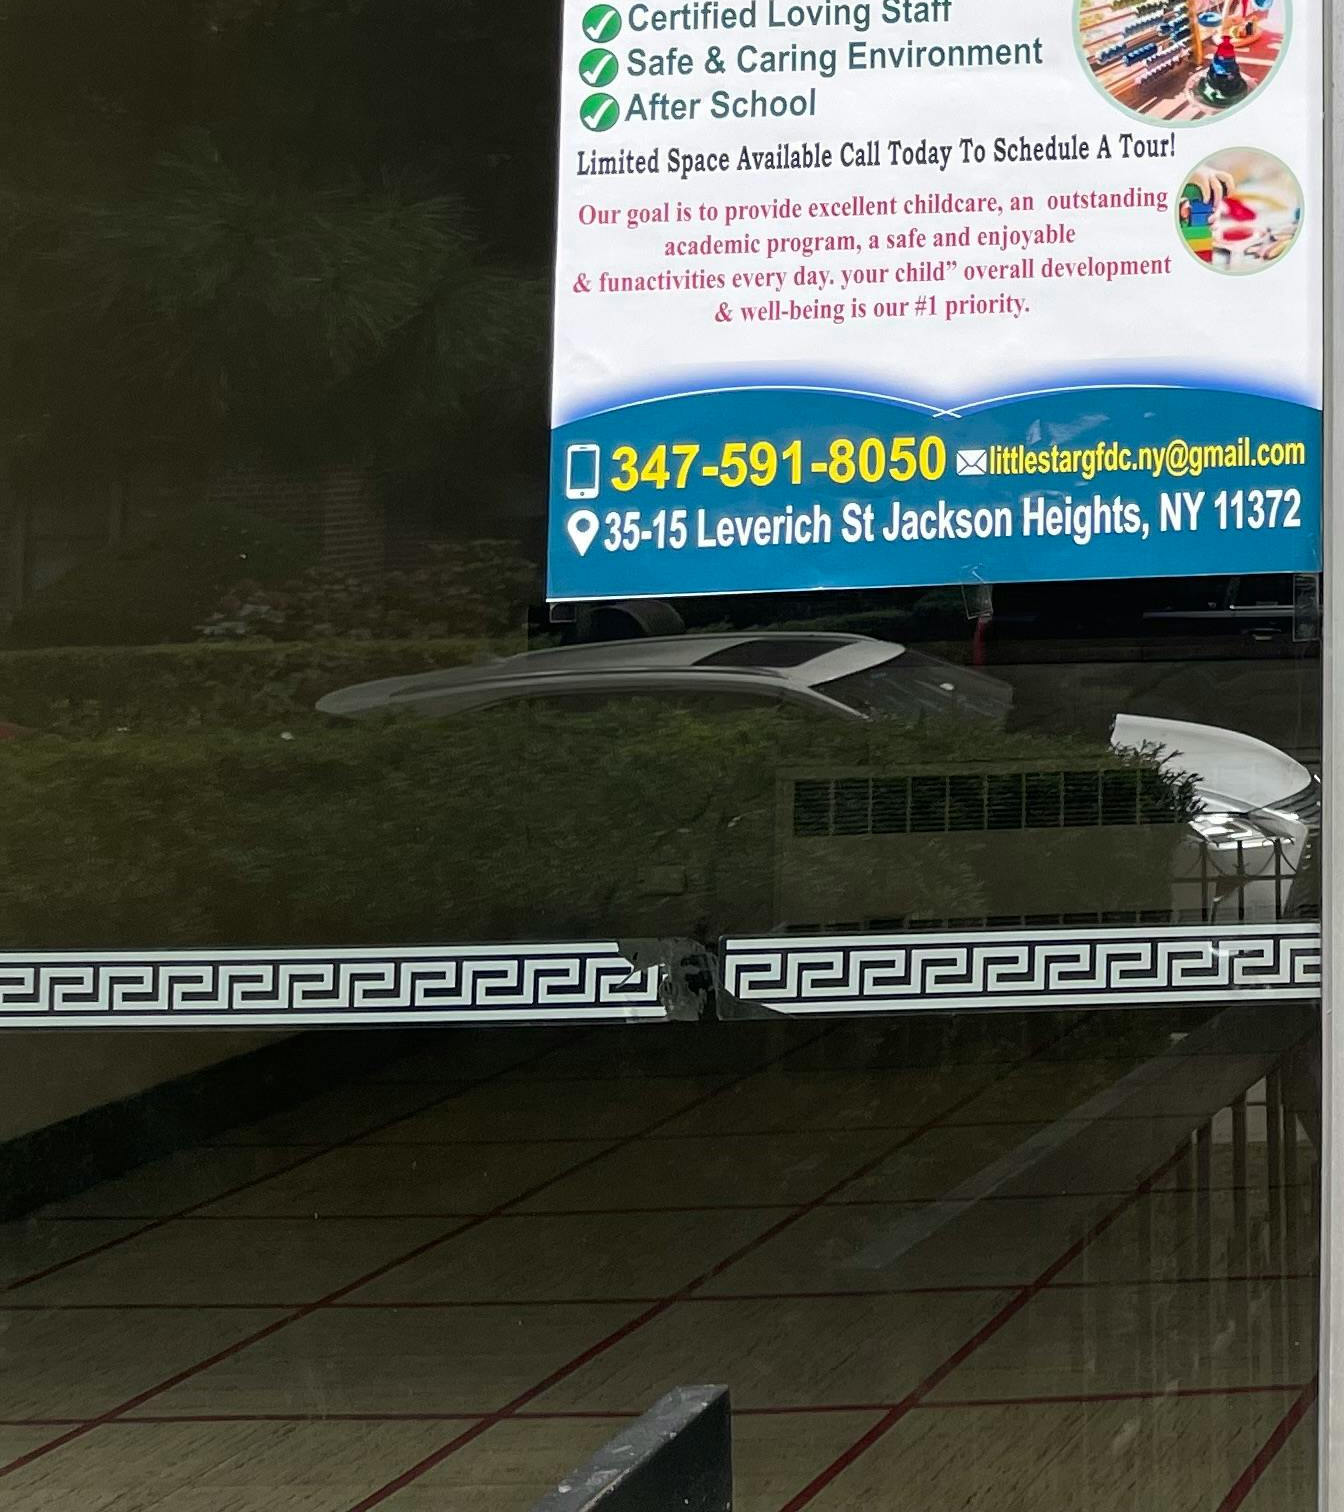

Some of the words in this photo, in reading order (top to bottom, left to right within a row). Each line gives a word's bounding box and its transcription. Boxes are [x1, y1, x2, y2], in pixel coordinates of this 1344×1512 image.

[629, 0, 756, 31] Certified
[627, 47, 693, 76] Safe
[705, 46, 726, 74] &
[738, 44, 836, 77] Caring
[849, 38, 1043, 69] Environment
[624, 93, 701, 121] After
[711, 88, 815, 118] School
[577, 148, 659, 175] Limited
[668, 148, 729, 179] Space
[737, 142, 832, 170] Available
[840, 140, 880, 167] Call
[888, 139, 952, 171] Today
[959, 138, 985, 163] To
[994, 134, 1089, 162] Schedule
[1097, 134, 1111, 159] A
[1119, 132, 1175, 158] Tour!
[579, 205, 621, 224] Our
[627, 202, 669, 229] goal
[677, 202, 691, 222] is
[699, 203, 718, 221] to
[725, 199, 801, 226] provide
[809, 196, 897, 217] excellent
[904, 193, 1002, 215] childcare,
[1011, 196, 1034, 210] an
[1048, 187, 1168, 212] outstanding
[665, 234, 760, 256] academic
[767, 236, 861, 258] program,
[869, 235, 879, 249] a
[887, 228, 926, 248] safe
[933, 227, 970, 247] and
[978, 224, 1075, 251] enjoyable
[573, 273, 591, 293] &
[599, 269, 725, 292] funactivities
[732, 272, 786, 292] every
[794, 266, 834, 290] day.
[841, 269, 889, 290] your
[964, 259, 1033, 280] overall
[1042, 256, 1171, 281] development
[715, 302, 732, 322] &
[741, 299, 845, 324] well-being
[851, 298, 866, 318] is
[874, 302, 909, 317] our
[915, 295, 936, 316] #1
[946, 293, 1029, 320] priority.
[611, 435, 946, 491] 347-591-8050
[989, 437, 1305, 480] littlestargfdc.ny@gmail.com
[604, 510, 687, 551] 35-15
[697, 505, 831, 547] Leverich
[842, 503, 874, 542] St
[883, 500, 1012, 541] Jackson
[1022, 495, 1149, 545] Heights,
[1161, 492, 1205, 531] NY
[1215, 488, 1300, 529] 11372
